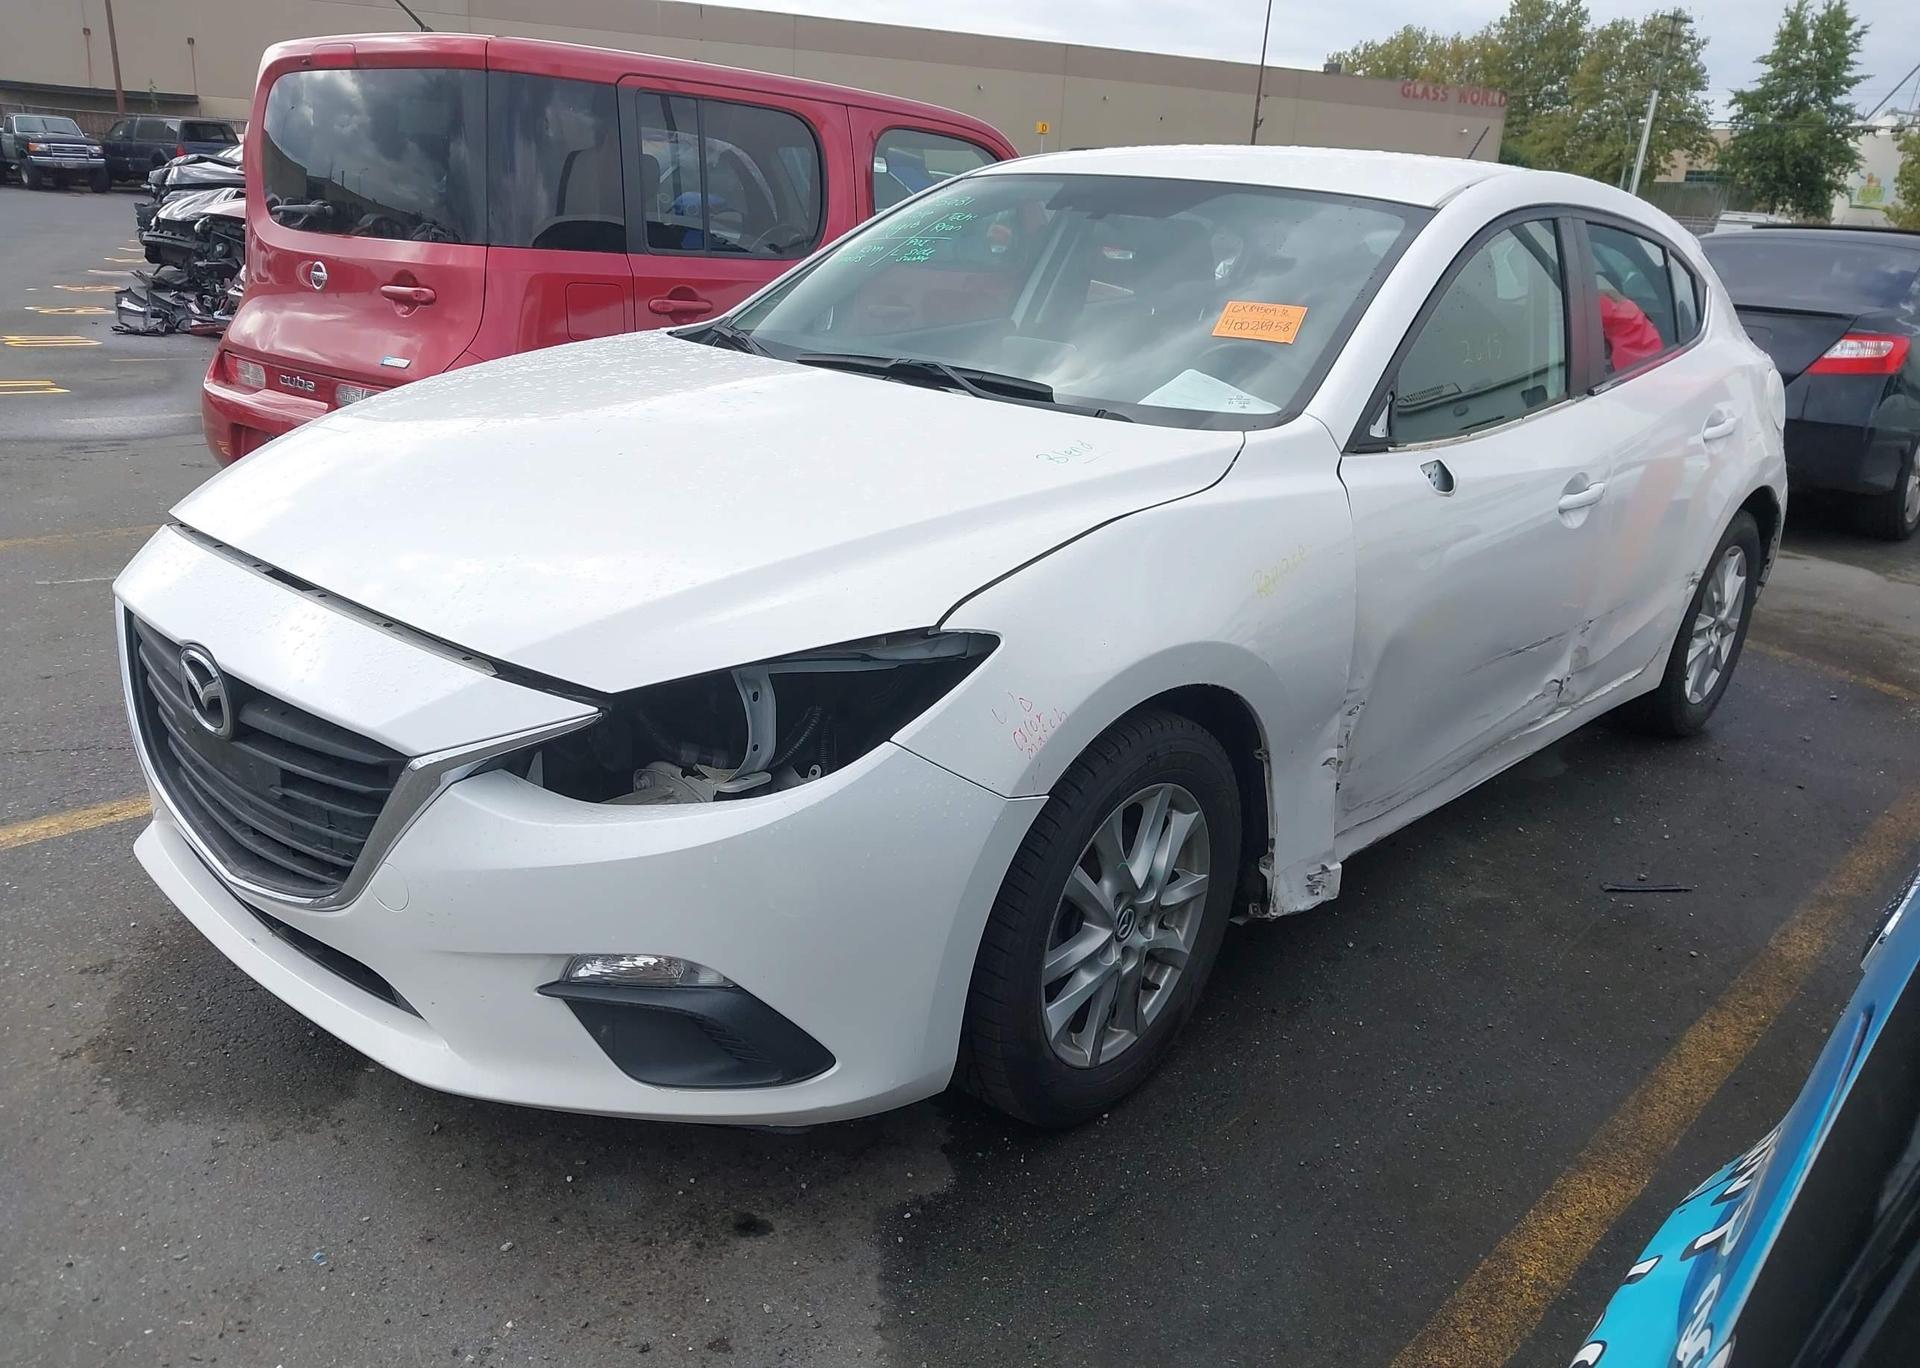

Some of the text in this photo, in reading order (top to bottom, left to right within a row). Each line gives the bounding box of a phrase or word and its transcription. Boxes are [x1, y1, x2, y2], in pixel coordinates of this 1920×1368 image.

[1400, 80, 1508, 107] GLASS WORLD
[278, 373, 316, 393] cube
